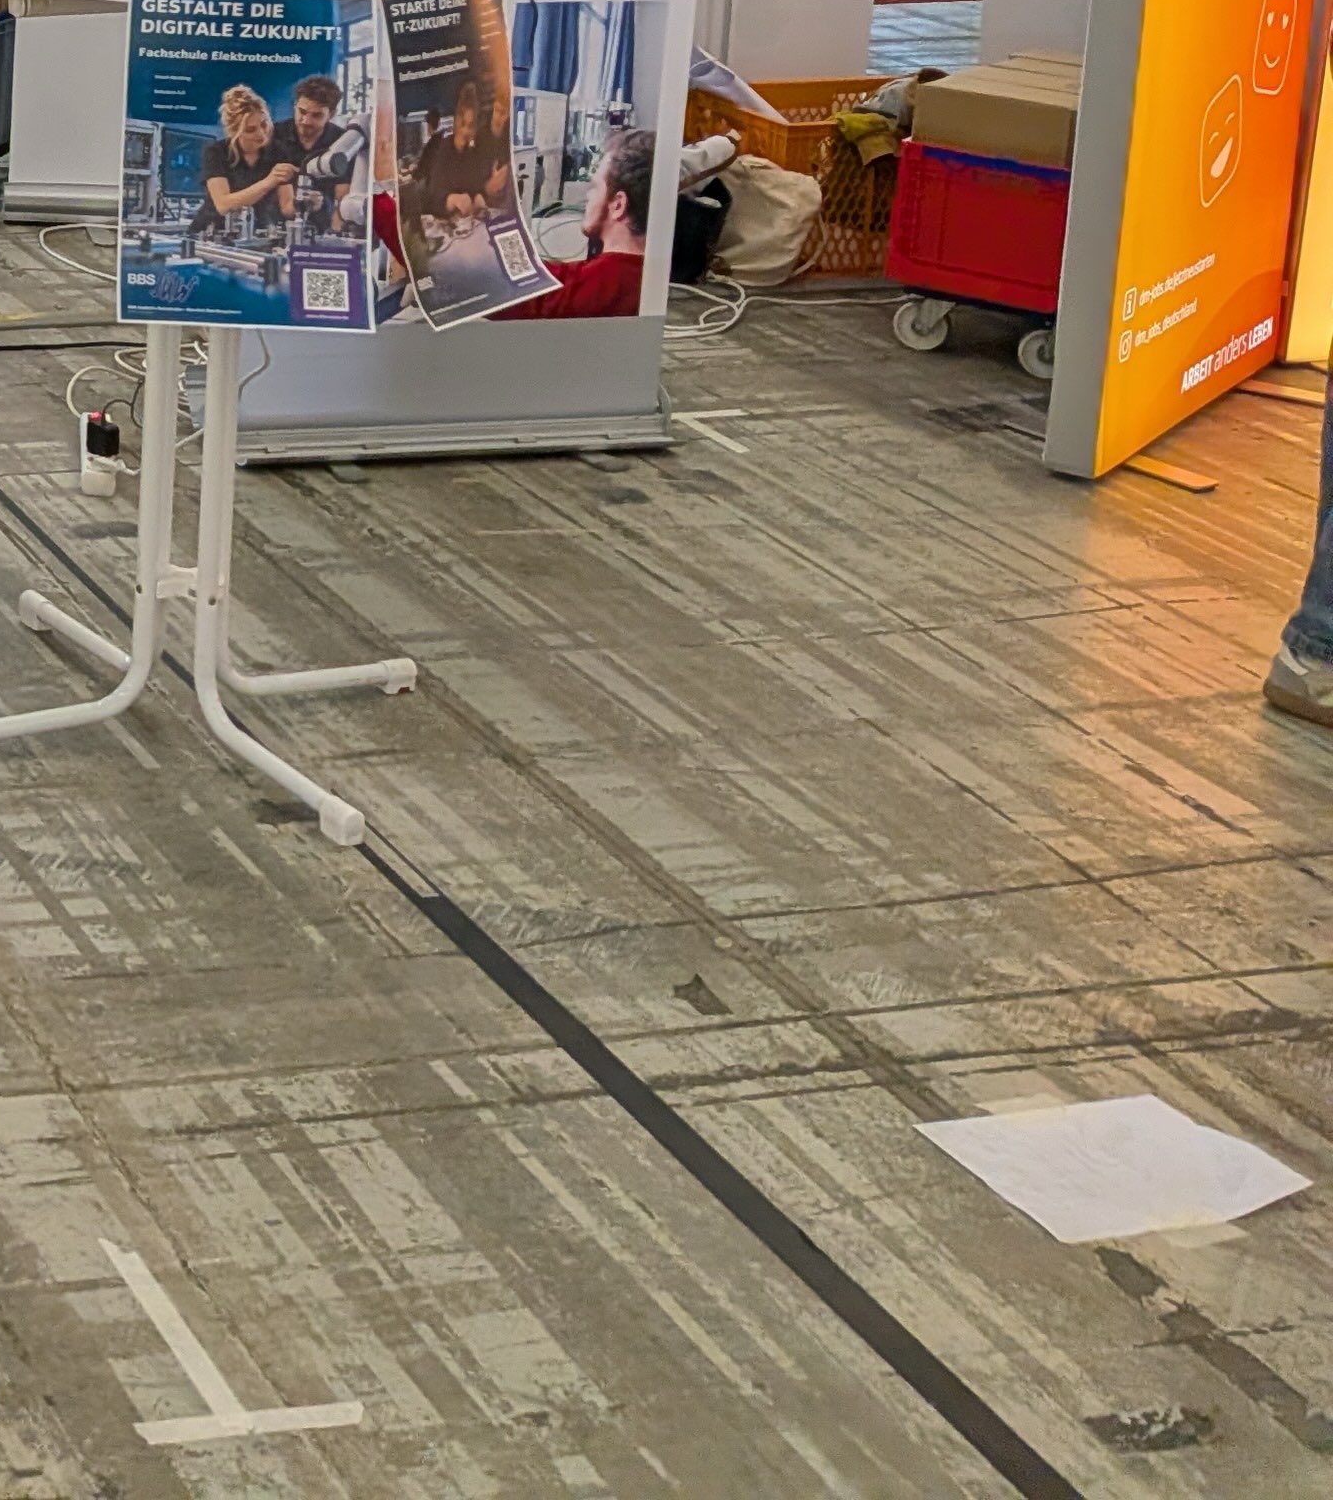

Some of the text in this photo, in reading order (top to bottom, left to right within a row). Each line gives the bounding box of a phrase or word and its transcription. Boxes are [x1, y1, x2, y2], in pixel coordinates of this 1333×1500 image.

[250, 3, 285, 18] DIE
[390, 0, 436, 17] STARTE
[140, 19, 342, 41] DIGITALE ZUKUNFT!
[139, 47, 303, 64] Fachschule Elektrotechnik
[1181, 315, 1274, 394] ARBEIT anders LEBEN
